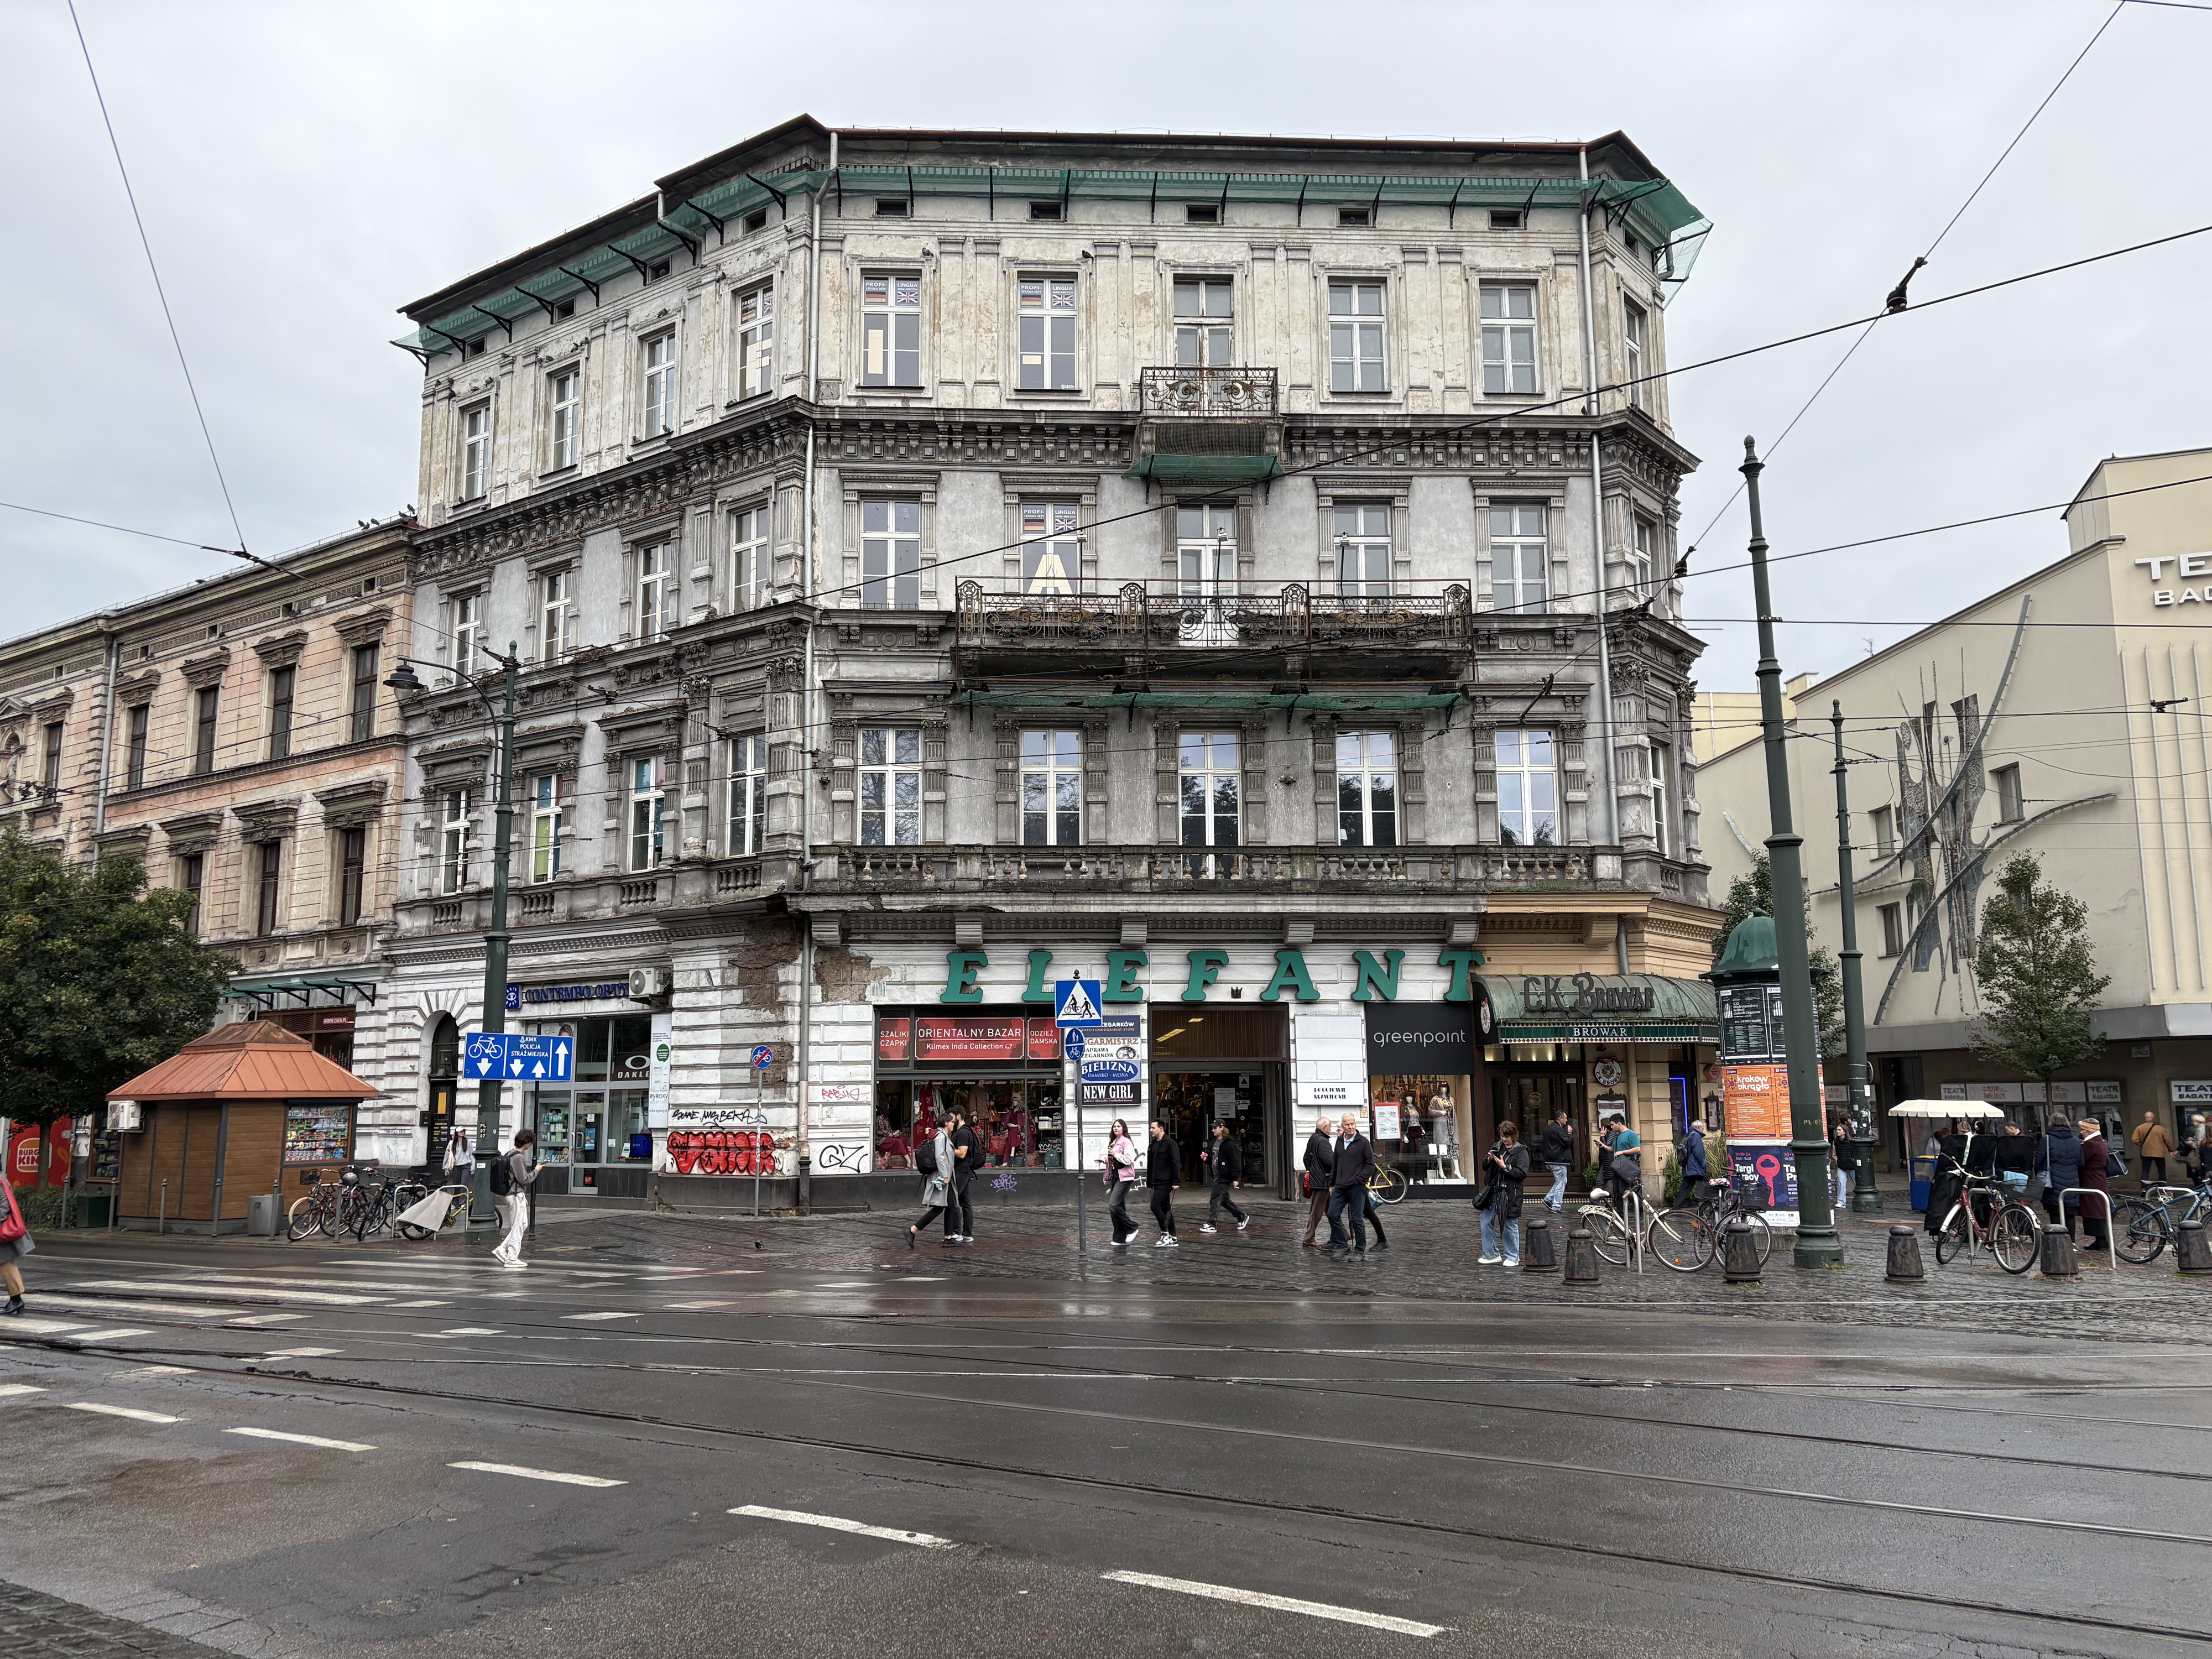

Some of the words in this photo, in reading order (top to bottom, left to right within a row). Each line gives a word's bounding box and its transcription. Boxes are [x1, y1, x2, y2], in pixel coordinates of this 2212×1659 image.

[940, 950, 1485, 1003] ELEFANT
[525, 985, 592, 1003] CONTEMPO
[594, 983, 629, 999] OPTY
[919, 1028, 984, 1037] ORIENTALNY
[988, 1028, 1021, 1037] BAZAR
[1373, 1029, 1465, 1047] greenpoint
[1573, 1027, 1628, 1037] BROWAR
[1081, 1061, 1135, 1074] BIELIZNA
[1602, 1072, 1621, 1085] BROWAR
[1083, 1085, 1107, 1099] NEW
[1109, 1084, 1134, 1098] GIRL
[18, 1156, 39, 1165] KIN
[1735, 1164, 1754, 1173] Targi
